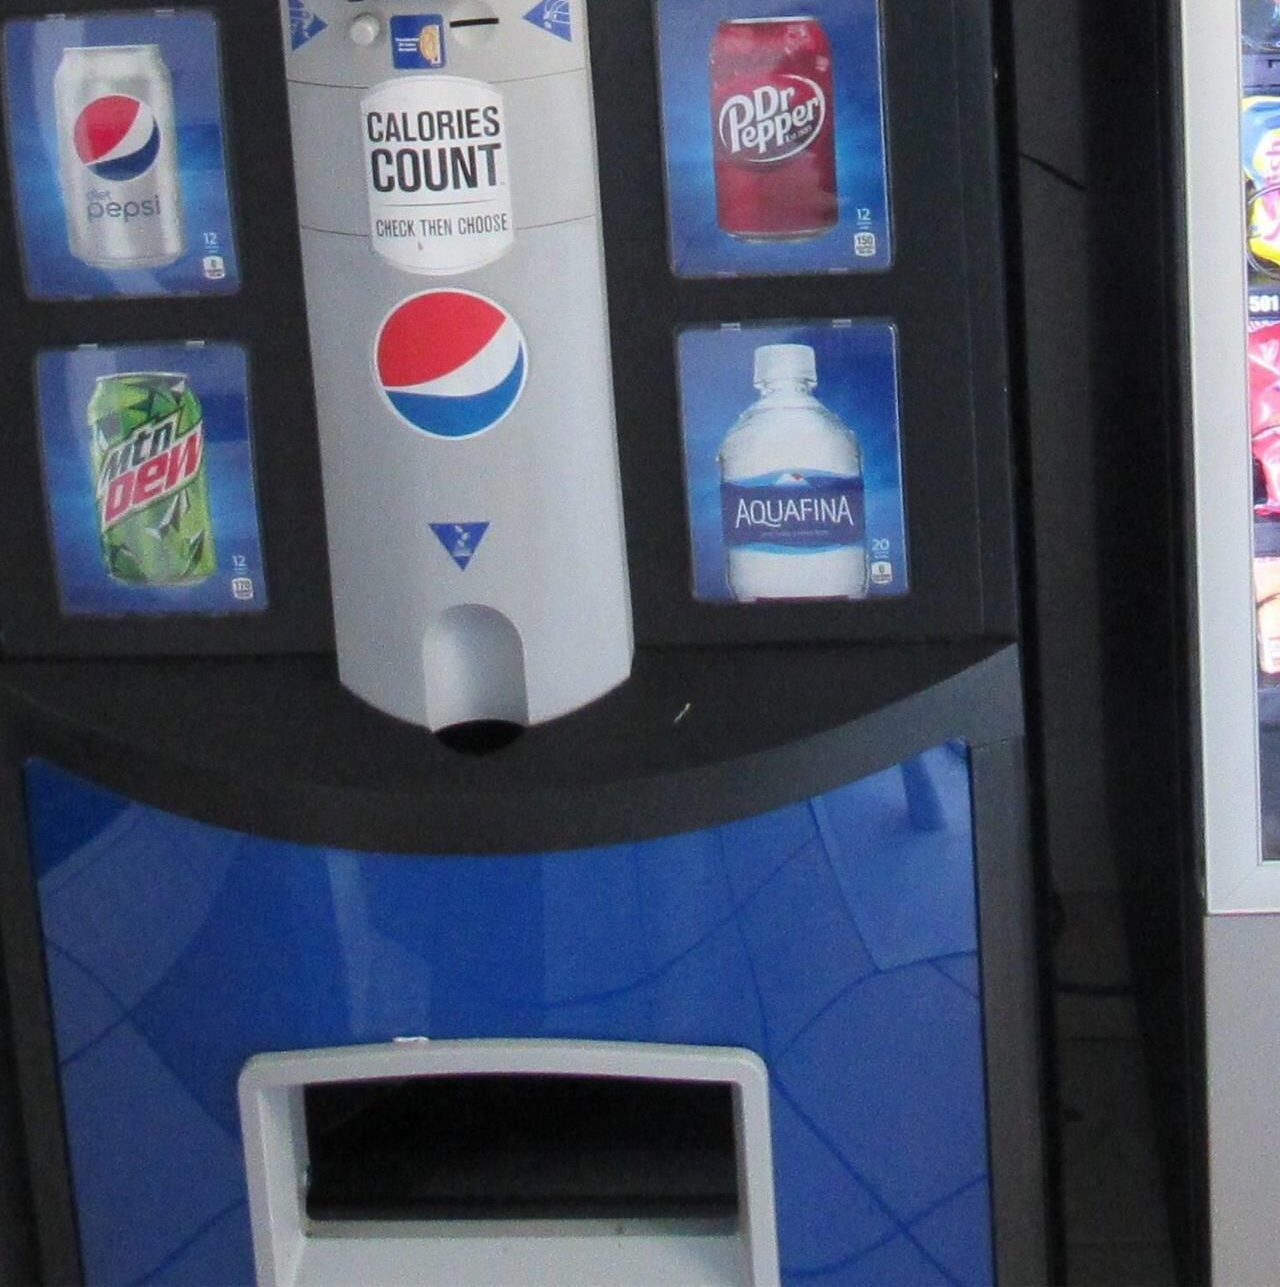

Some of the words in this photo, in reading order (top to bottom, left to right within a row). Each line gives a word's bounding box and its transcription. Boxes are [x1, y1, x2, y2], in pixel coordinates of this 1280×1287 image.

[753, 85, 795, 121] Dr
[367, 105, 501, 143] CALORIES
[725, 95, 820, 154] Pepper
[371, 143, 502, 193] COUNT
[86, 188, 112, 201] diet
[87, 194, 161, 223] pepsi
[856, 207, 871, 222] 12
[376, 218, 416, 238] CHECK
[419, 218, 454, 238] THEN
[458, 213, 509, 236] CHOOSE
[202, 232, 218, 245] 12
[1249, 294, 1280, 312] 501
[734, 495, 855, 529] AQUAFINA
[871, 538, 890, 551] 20
[231, 554, 247, 568] 12
